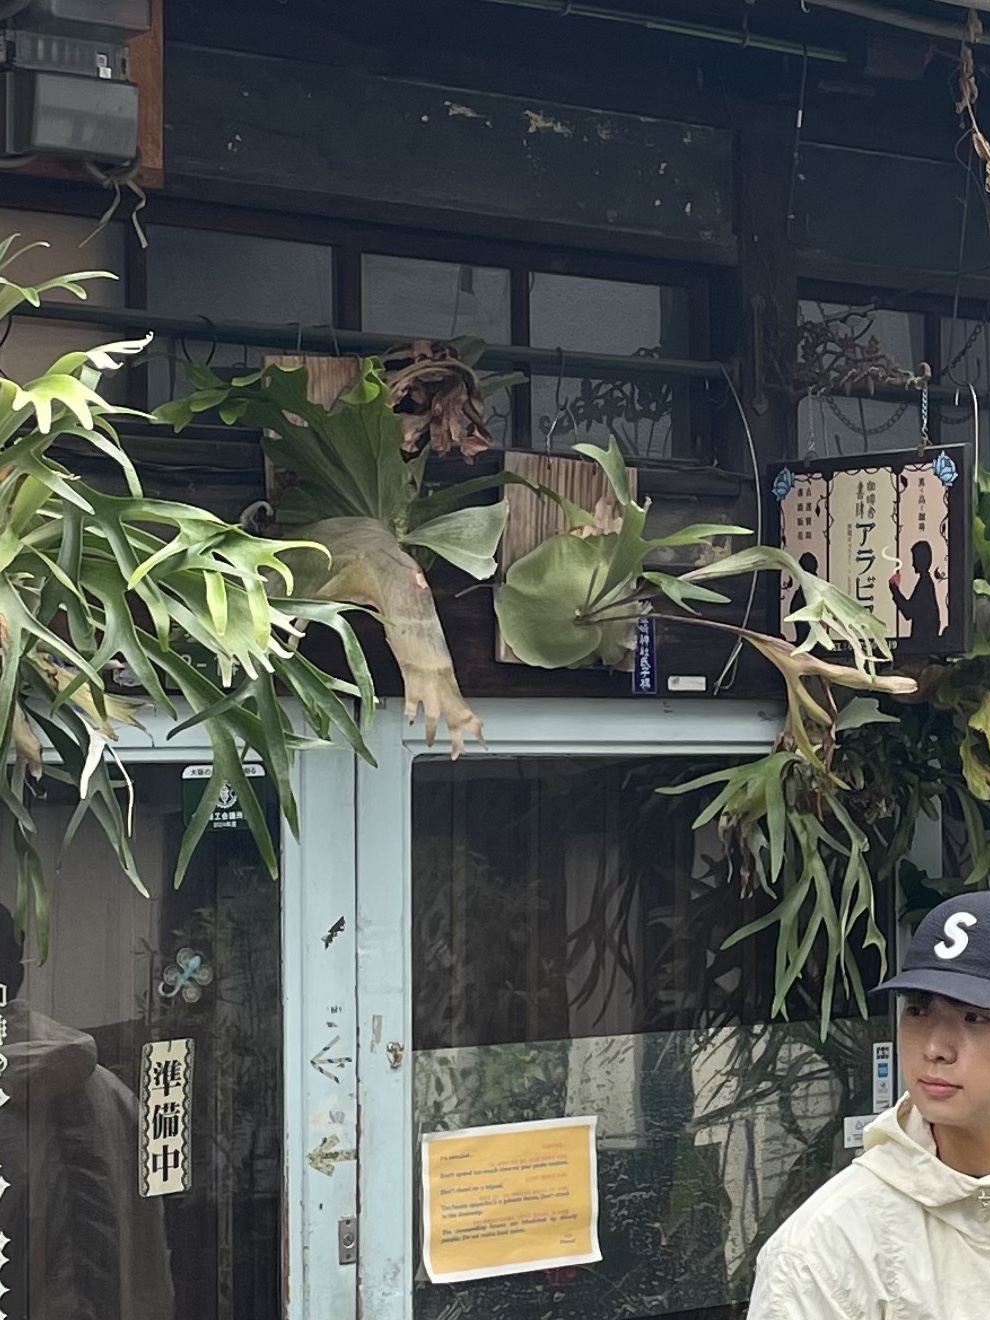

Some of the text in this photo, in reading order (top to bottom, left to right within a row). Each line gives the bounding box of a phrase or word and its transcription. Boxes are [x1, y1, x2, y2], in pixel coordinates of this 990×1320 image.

[934, 911, 977, 960] S
[152, 1060, 182, 1182] 準備中
